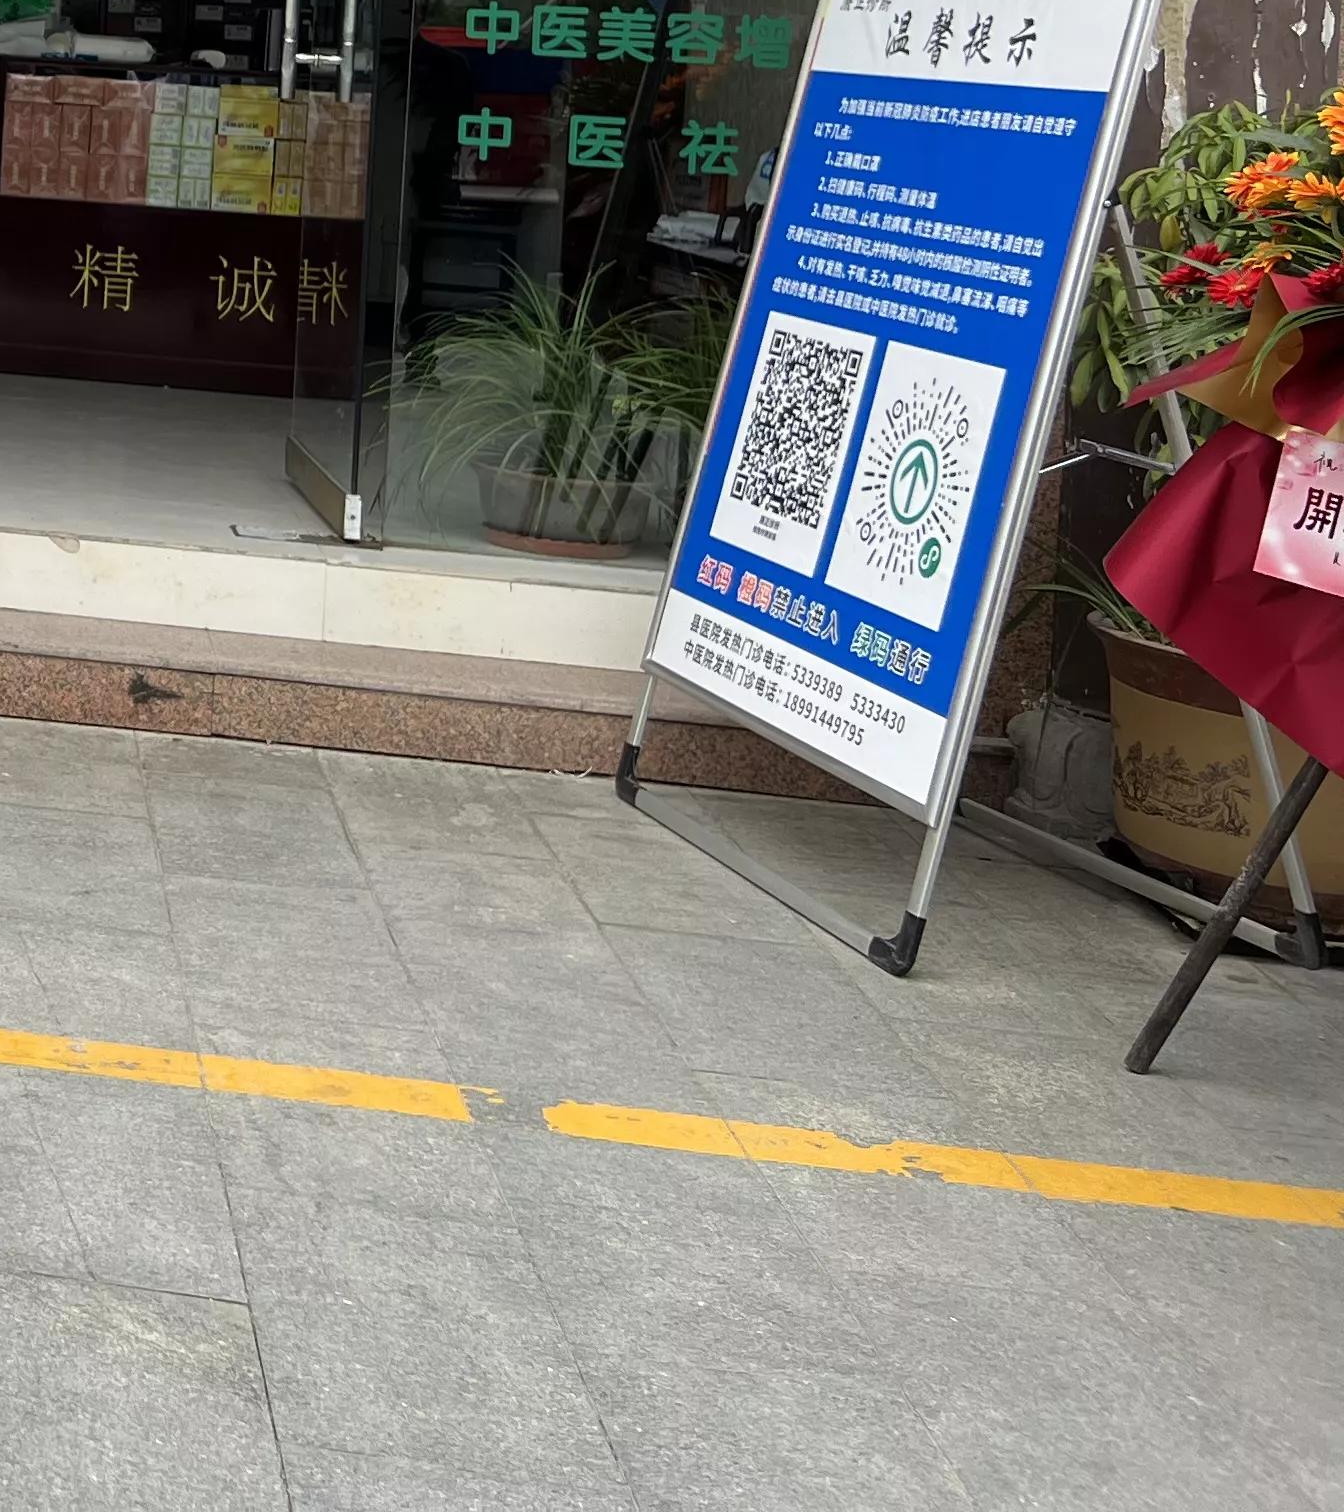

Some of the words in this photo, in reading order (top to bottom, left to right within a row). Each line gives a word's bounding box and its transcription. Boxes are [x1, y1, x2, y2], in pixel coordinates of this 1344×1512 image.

[883, 7, 1039, 69] 温馨提示
[849, 694, 906, 735] 5333430
